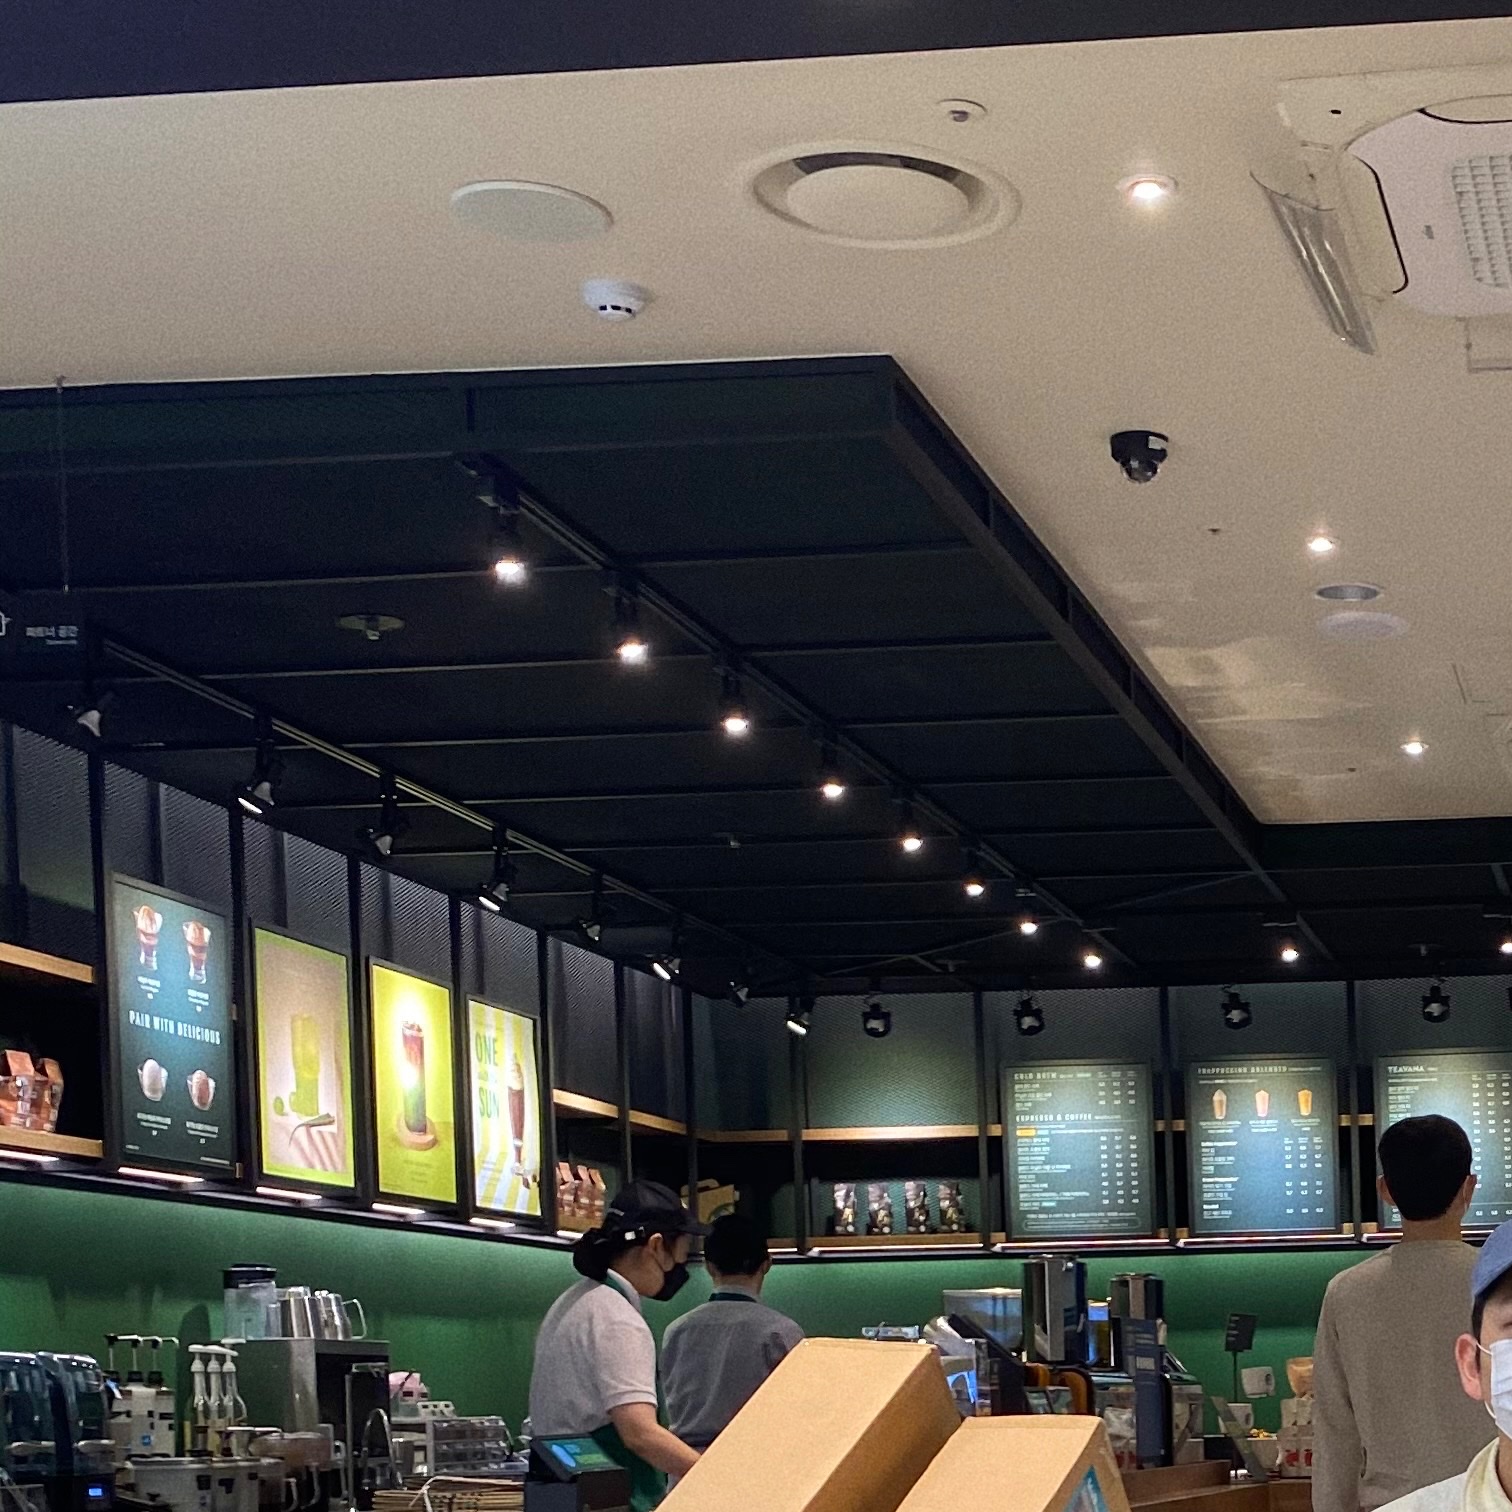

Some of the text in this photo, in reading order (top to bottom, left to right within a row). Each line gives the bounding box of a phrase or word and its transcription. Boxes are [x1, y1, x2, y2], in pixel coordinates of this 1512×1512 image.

[128, 1009, 221, 1045] PAIR WITH DELICIOUS
[475, 1031, 498, 1067] ONE
[1387, 1065, 1426, 1074] TEAVANA
[478, 1086, 500, 1119] SUN
